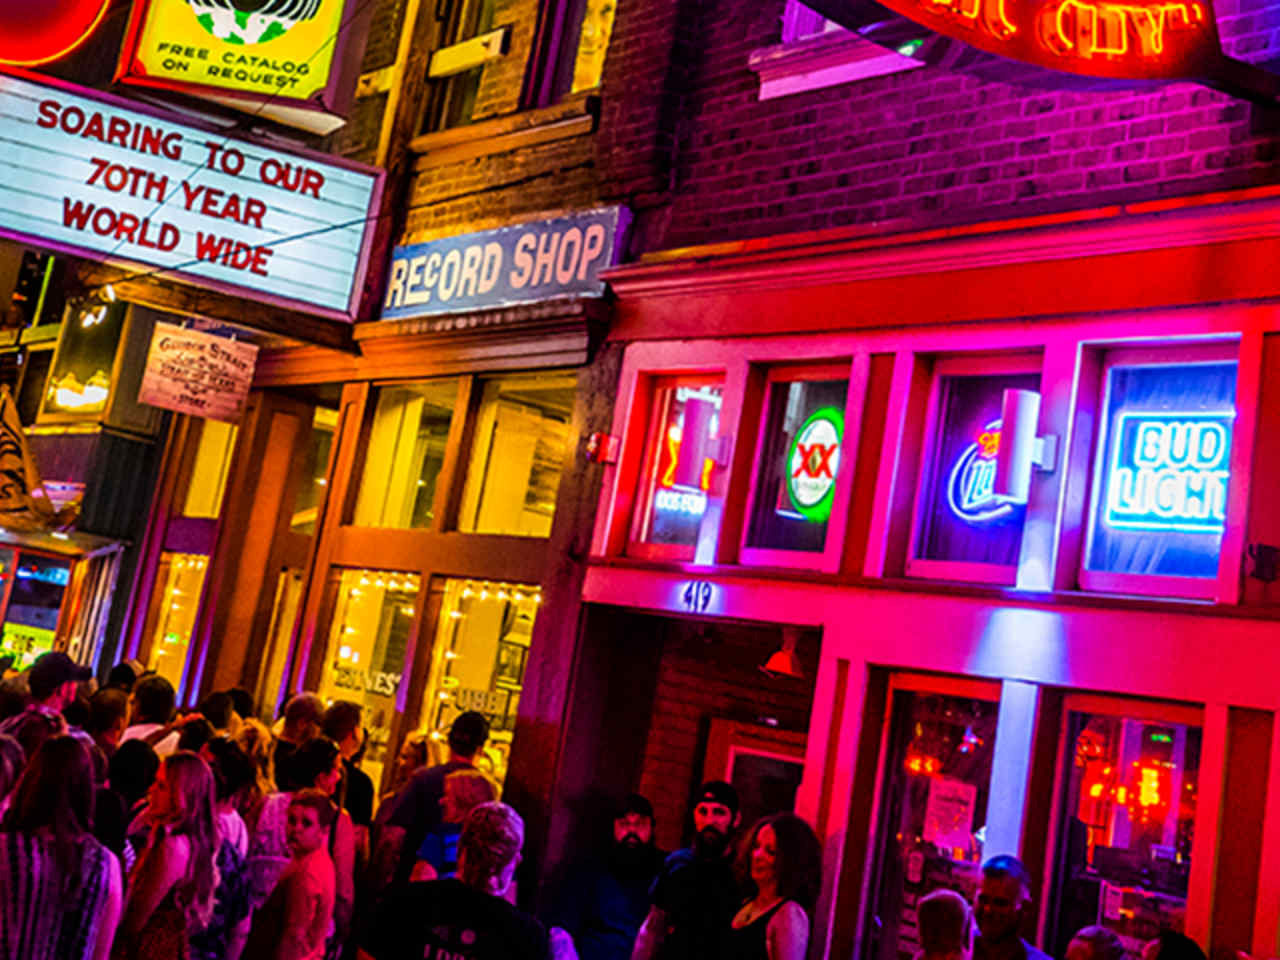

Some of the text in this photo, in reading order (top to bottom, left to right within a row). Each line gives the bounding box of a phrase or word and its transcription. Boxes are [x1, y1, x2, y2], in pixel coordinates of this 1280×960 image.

[156, 42, 310, 76] FREE CATALOG
[162, 58, 300, 89] ON REQUEST
[36, 99, 325, 199] SOARING TO OUR
[85, 157, 267, 229] 70TH YEAR
[62, 196, 274, 277] WORLD WIDE
[385, 224, 605, 308] RECORD SHOP
[793, 442, 839, 479] XX
[1133, 422, 1227, 469] BUD
[683, 581, 713, 614] 419
